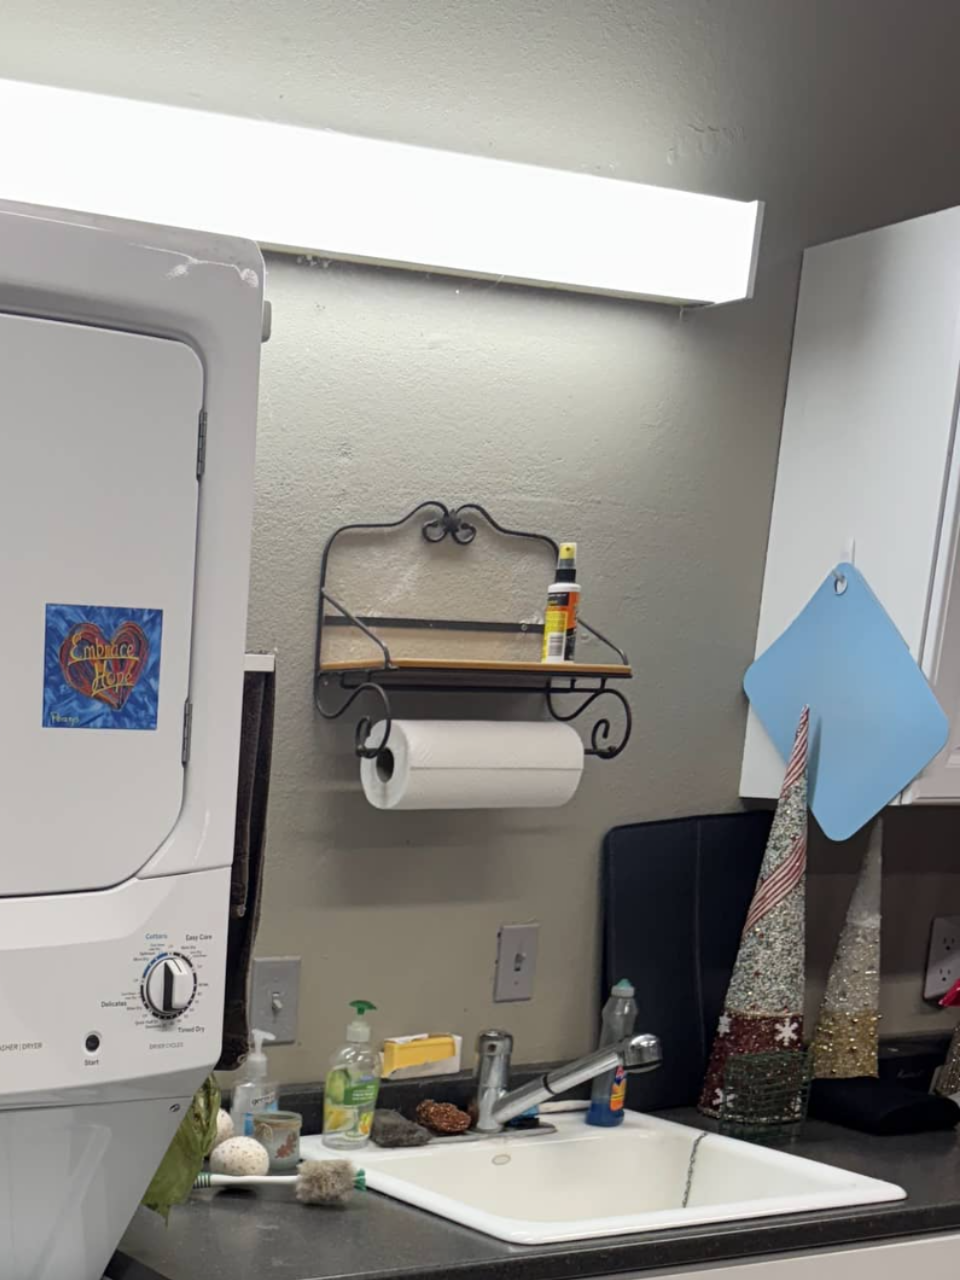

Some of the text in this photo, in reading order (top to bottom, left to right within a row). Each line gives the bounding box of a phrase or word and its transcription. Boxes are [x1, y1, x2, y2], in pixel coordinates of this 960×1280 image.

[69, 634, 137, 662] Embrace
[91, 660, 134, 695] Hope
[185, 934, 198, 942] Easy
